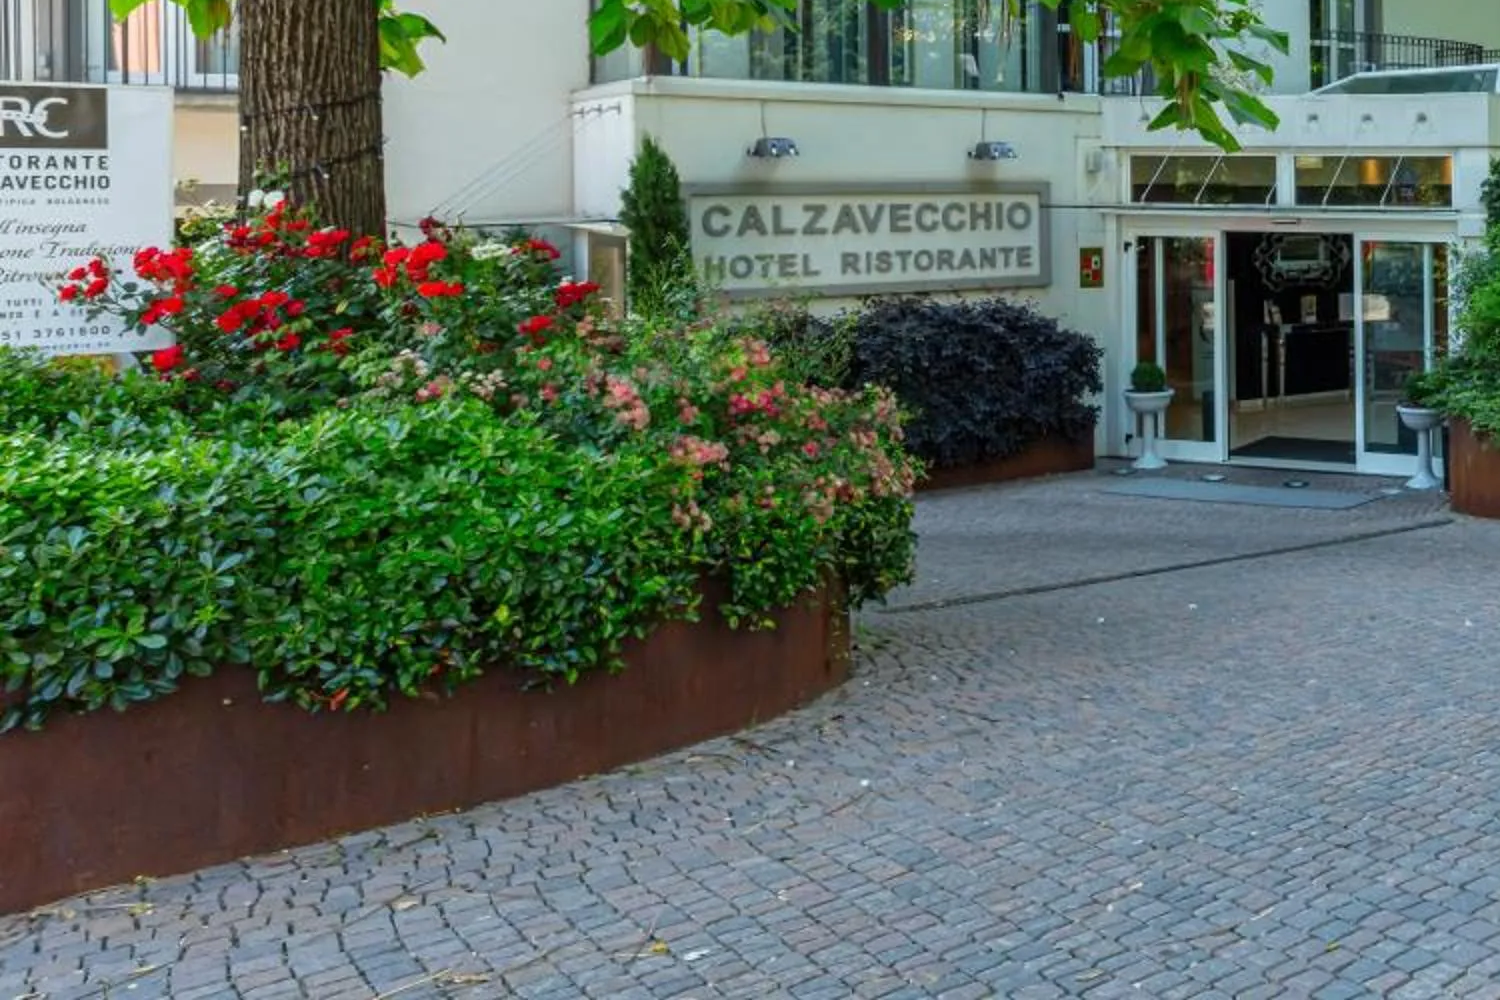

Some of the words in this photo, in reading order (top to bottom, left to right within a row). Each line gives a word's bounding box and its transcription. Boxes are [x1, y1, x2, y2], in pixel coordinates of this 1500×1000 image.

[0, 155, 109, 171] ORANTE
[702, 202, 1032, 238] CALZAVECCHIO
[703, 254, 821, 281] HOTEL
[841, 246, 1032, 275] RISTORANTE
